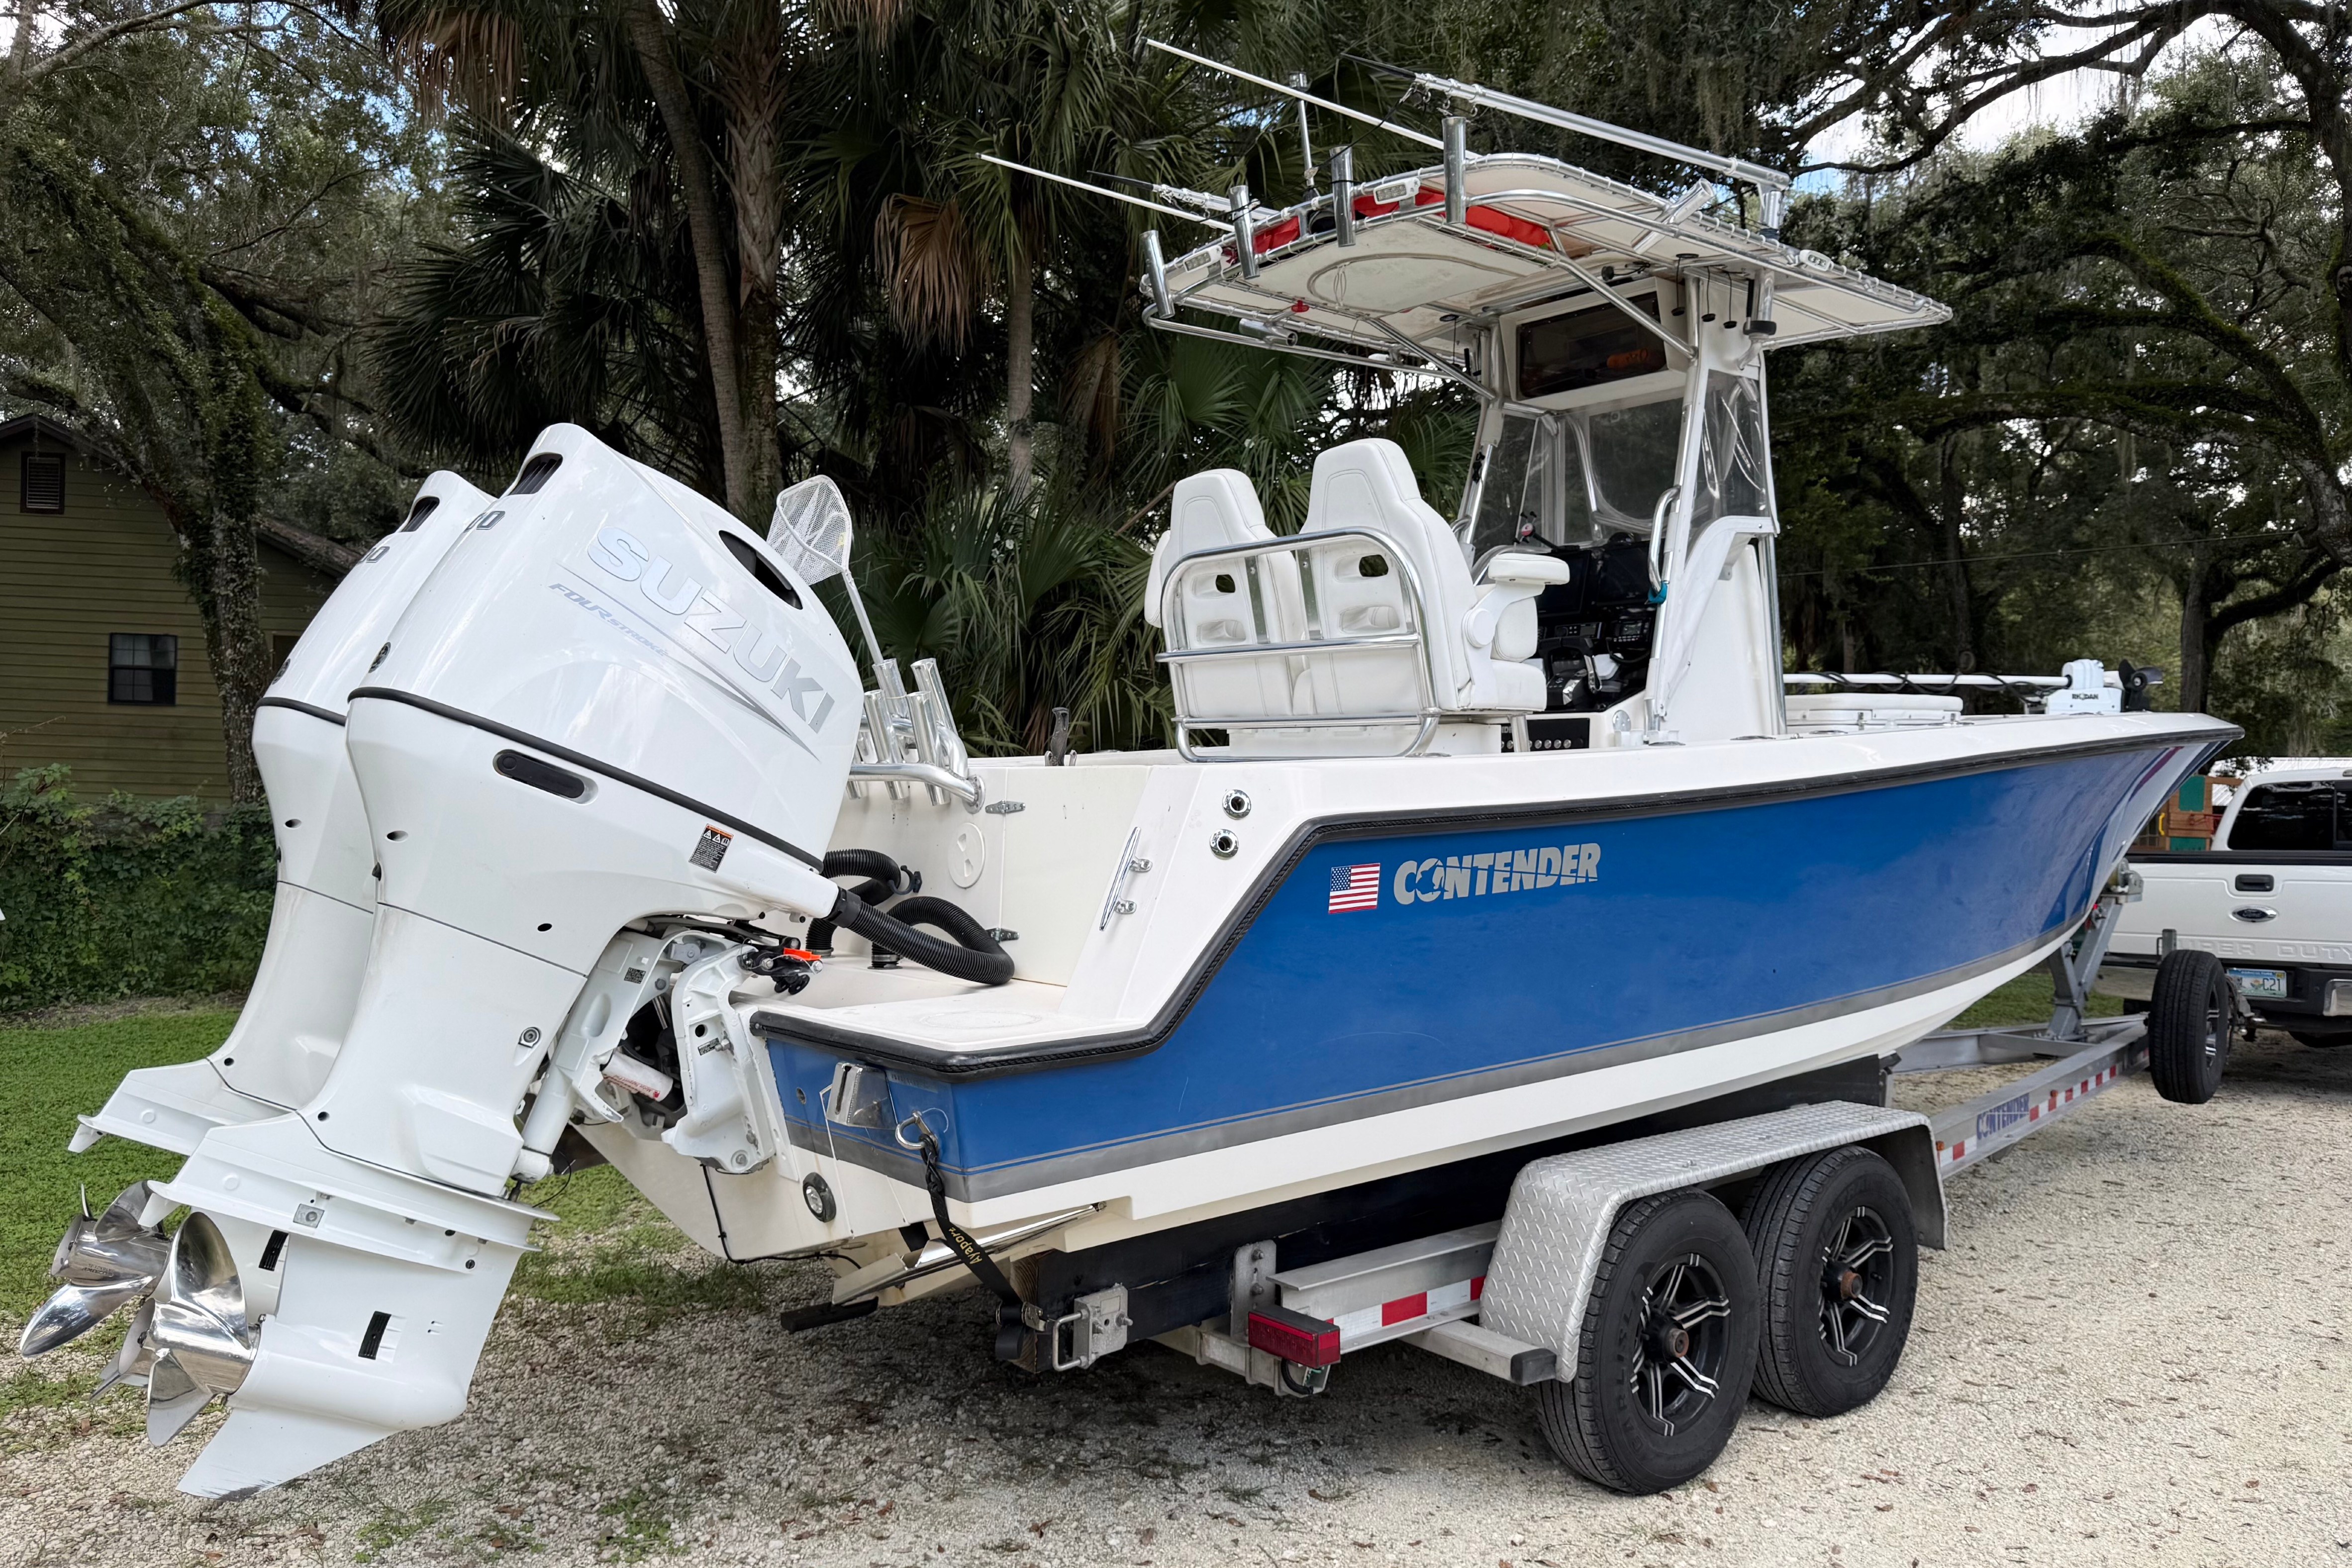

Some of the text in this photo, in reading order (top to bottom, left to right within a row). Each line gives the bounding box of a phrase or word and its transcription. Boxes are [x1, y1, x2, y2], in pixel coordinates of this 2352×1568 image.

[587, 526, 835, 734] SUZUKI
[1393, 843, 1601, 905] CONTENDER
[1977, 1092, 2030, 1140] CONTENDER
